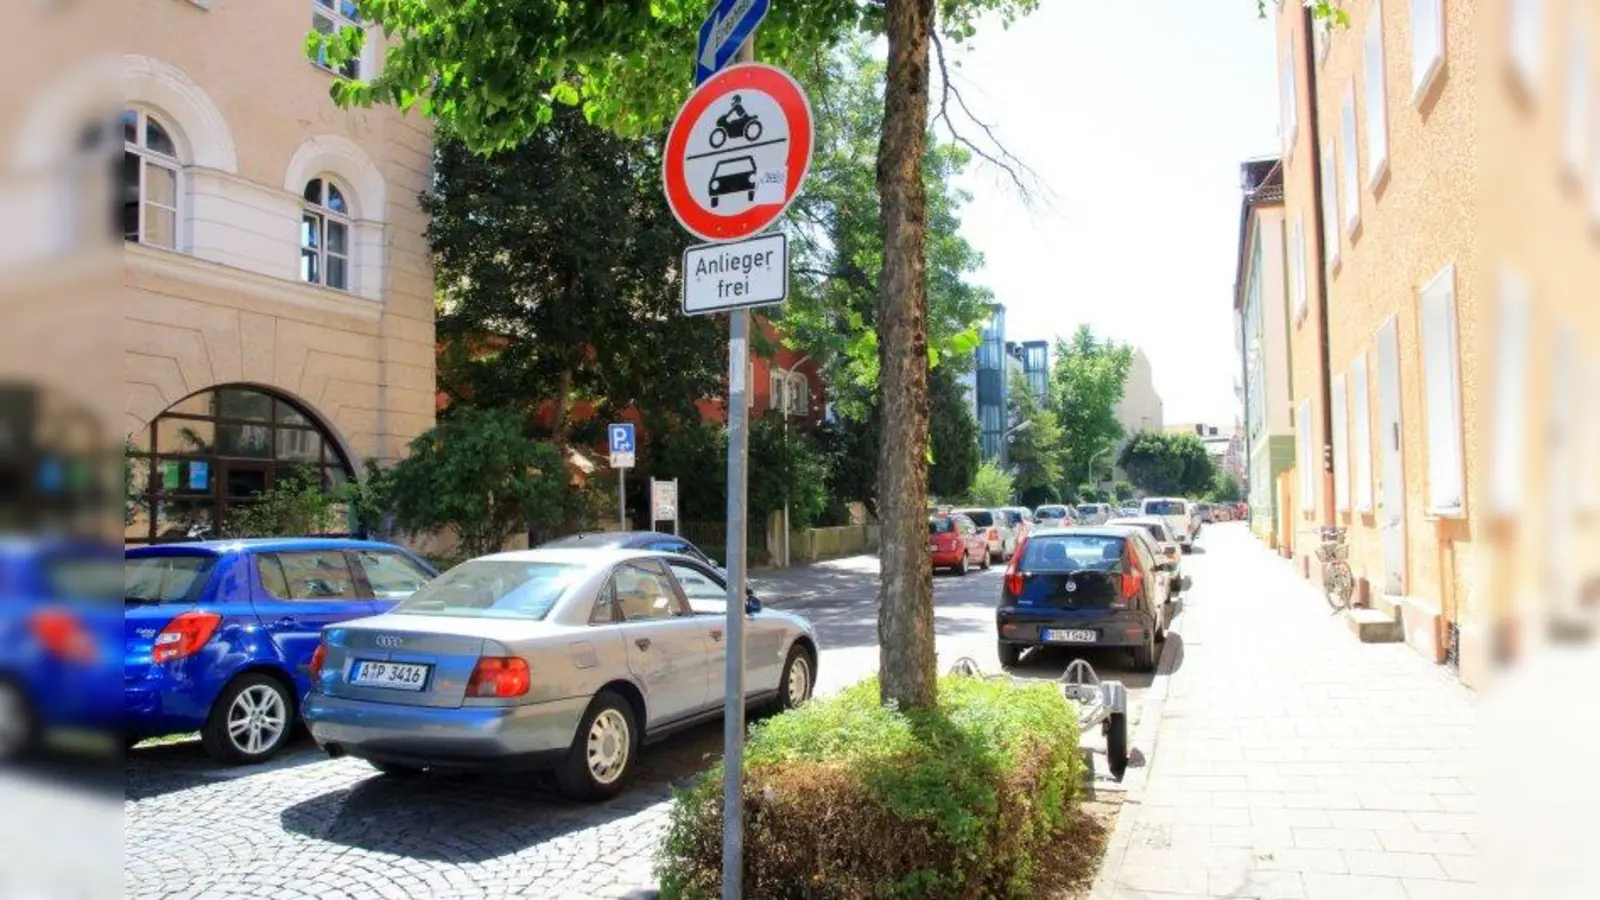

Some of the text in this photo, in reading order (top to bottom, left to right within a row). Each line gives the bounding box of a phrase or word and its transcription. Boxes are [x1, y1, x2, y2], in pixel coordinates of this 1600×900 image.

[695, 250, 774, 274] Anlieger
[717, 275, 749, 298] frei
[613, 427, 627, 450] P
[388, 666, 421, 683] 3416
